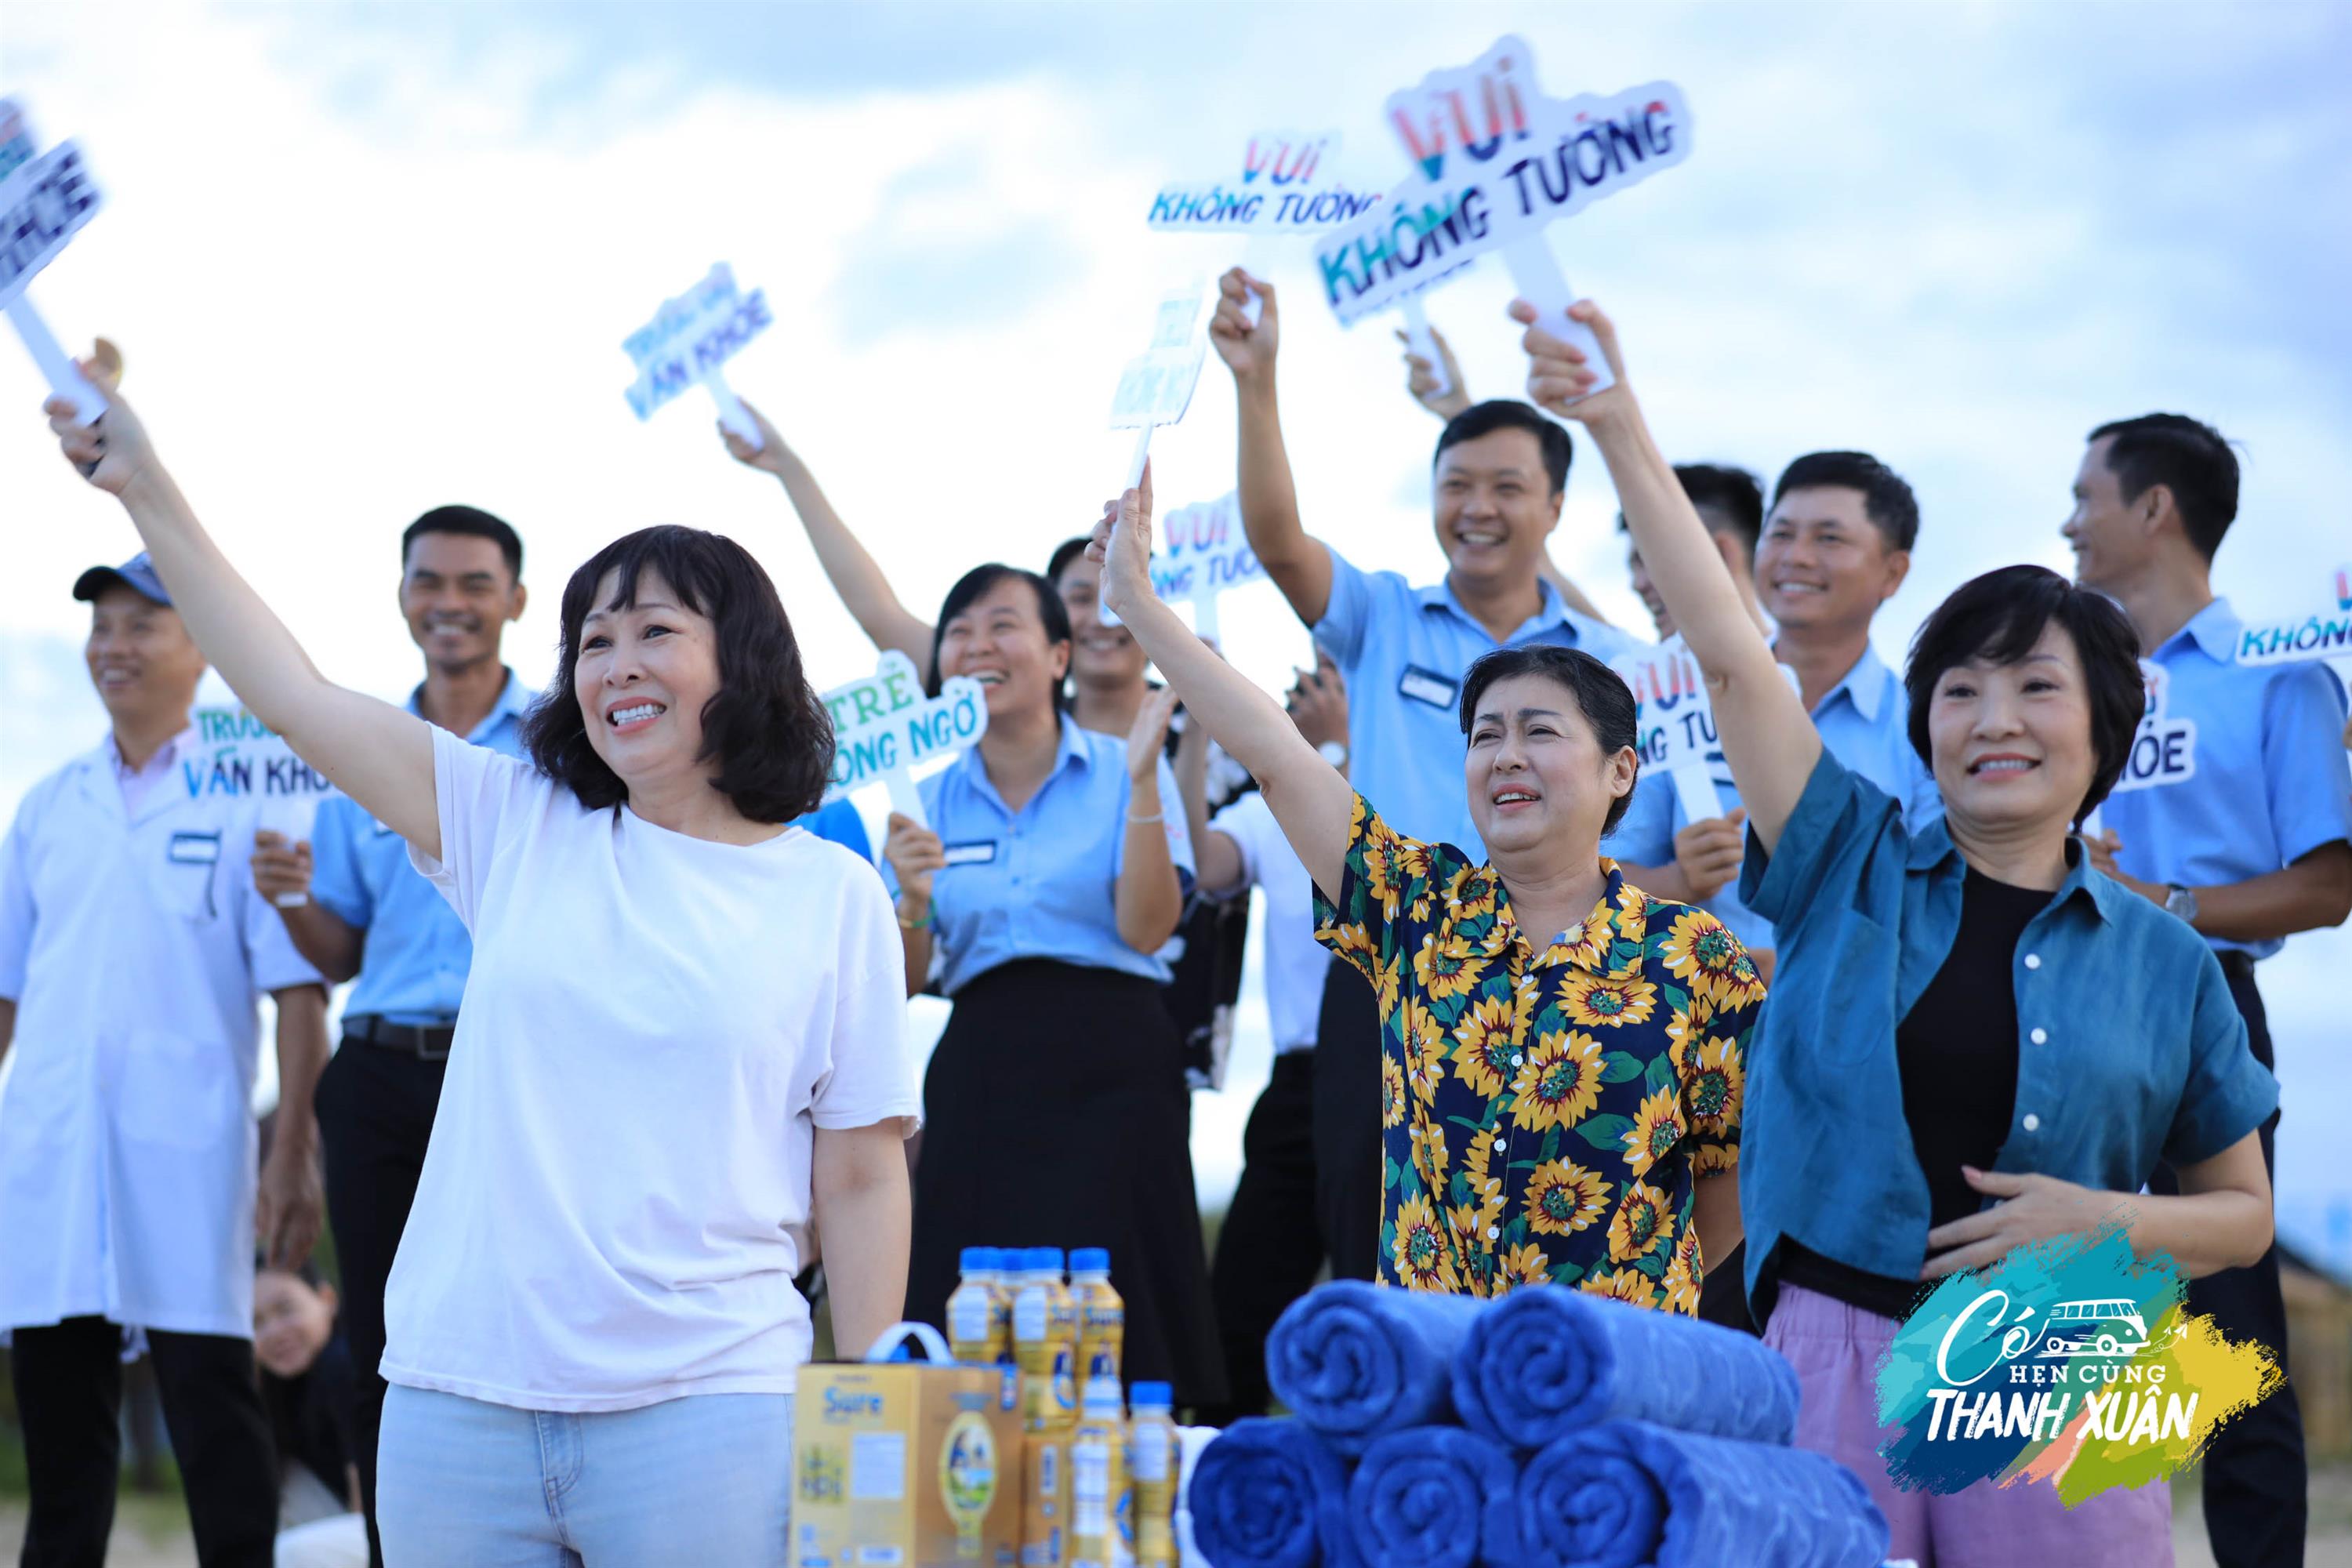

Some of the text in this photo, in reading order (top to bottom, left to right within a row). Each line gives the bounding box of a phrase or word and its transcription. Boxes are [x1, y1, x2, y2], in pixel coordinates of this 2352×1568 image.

[1148, 185, 1264, 223] KHÔNG
[1318, 185, 1491, 307] KHÔNG
[2241, 616, 2352, 657] KHÔN
[834, 731, 896, 786] ÔNG
